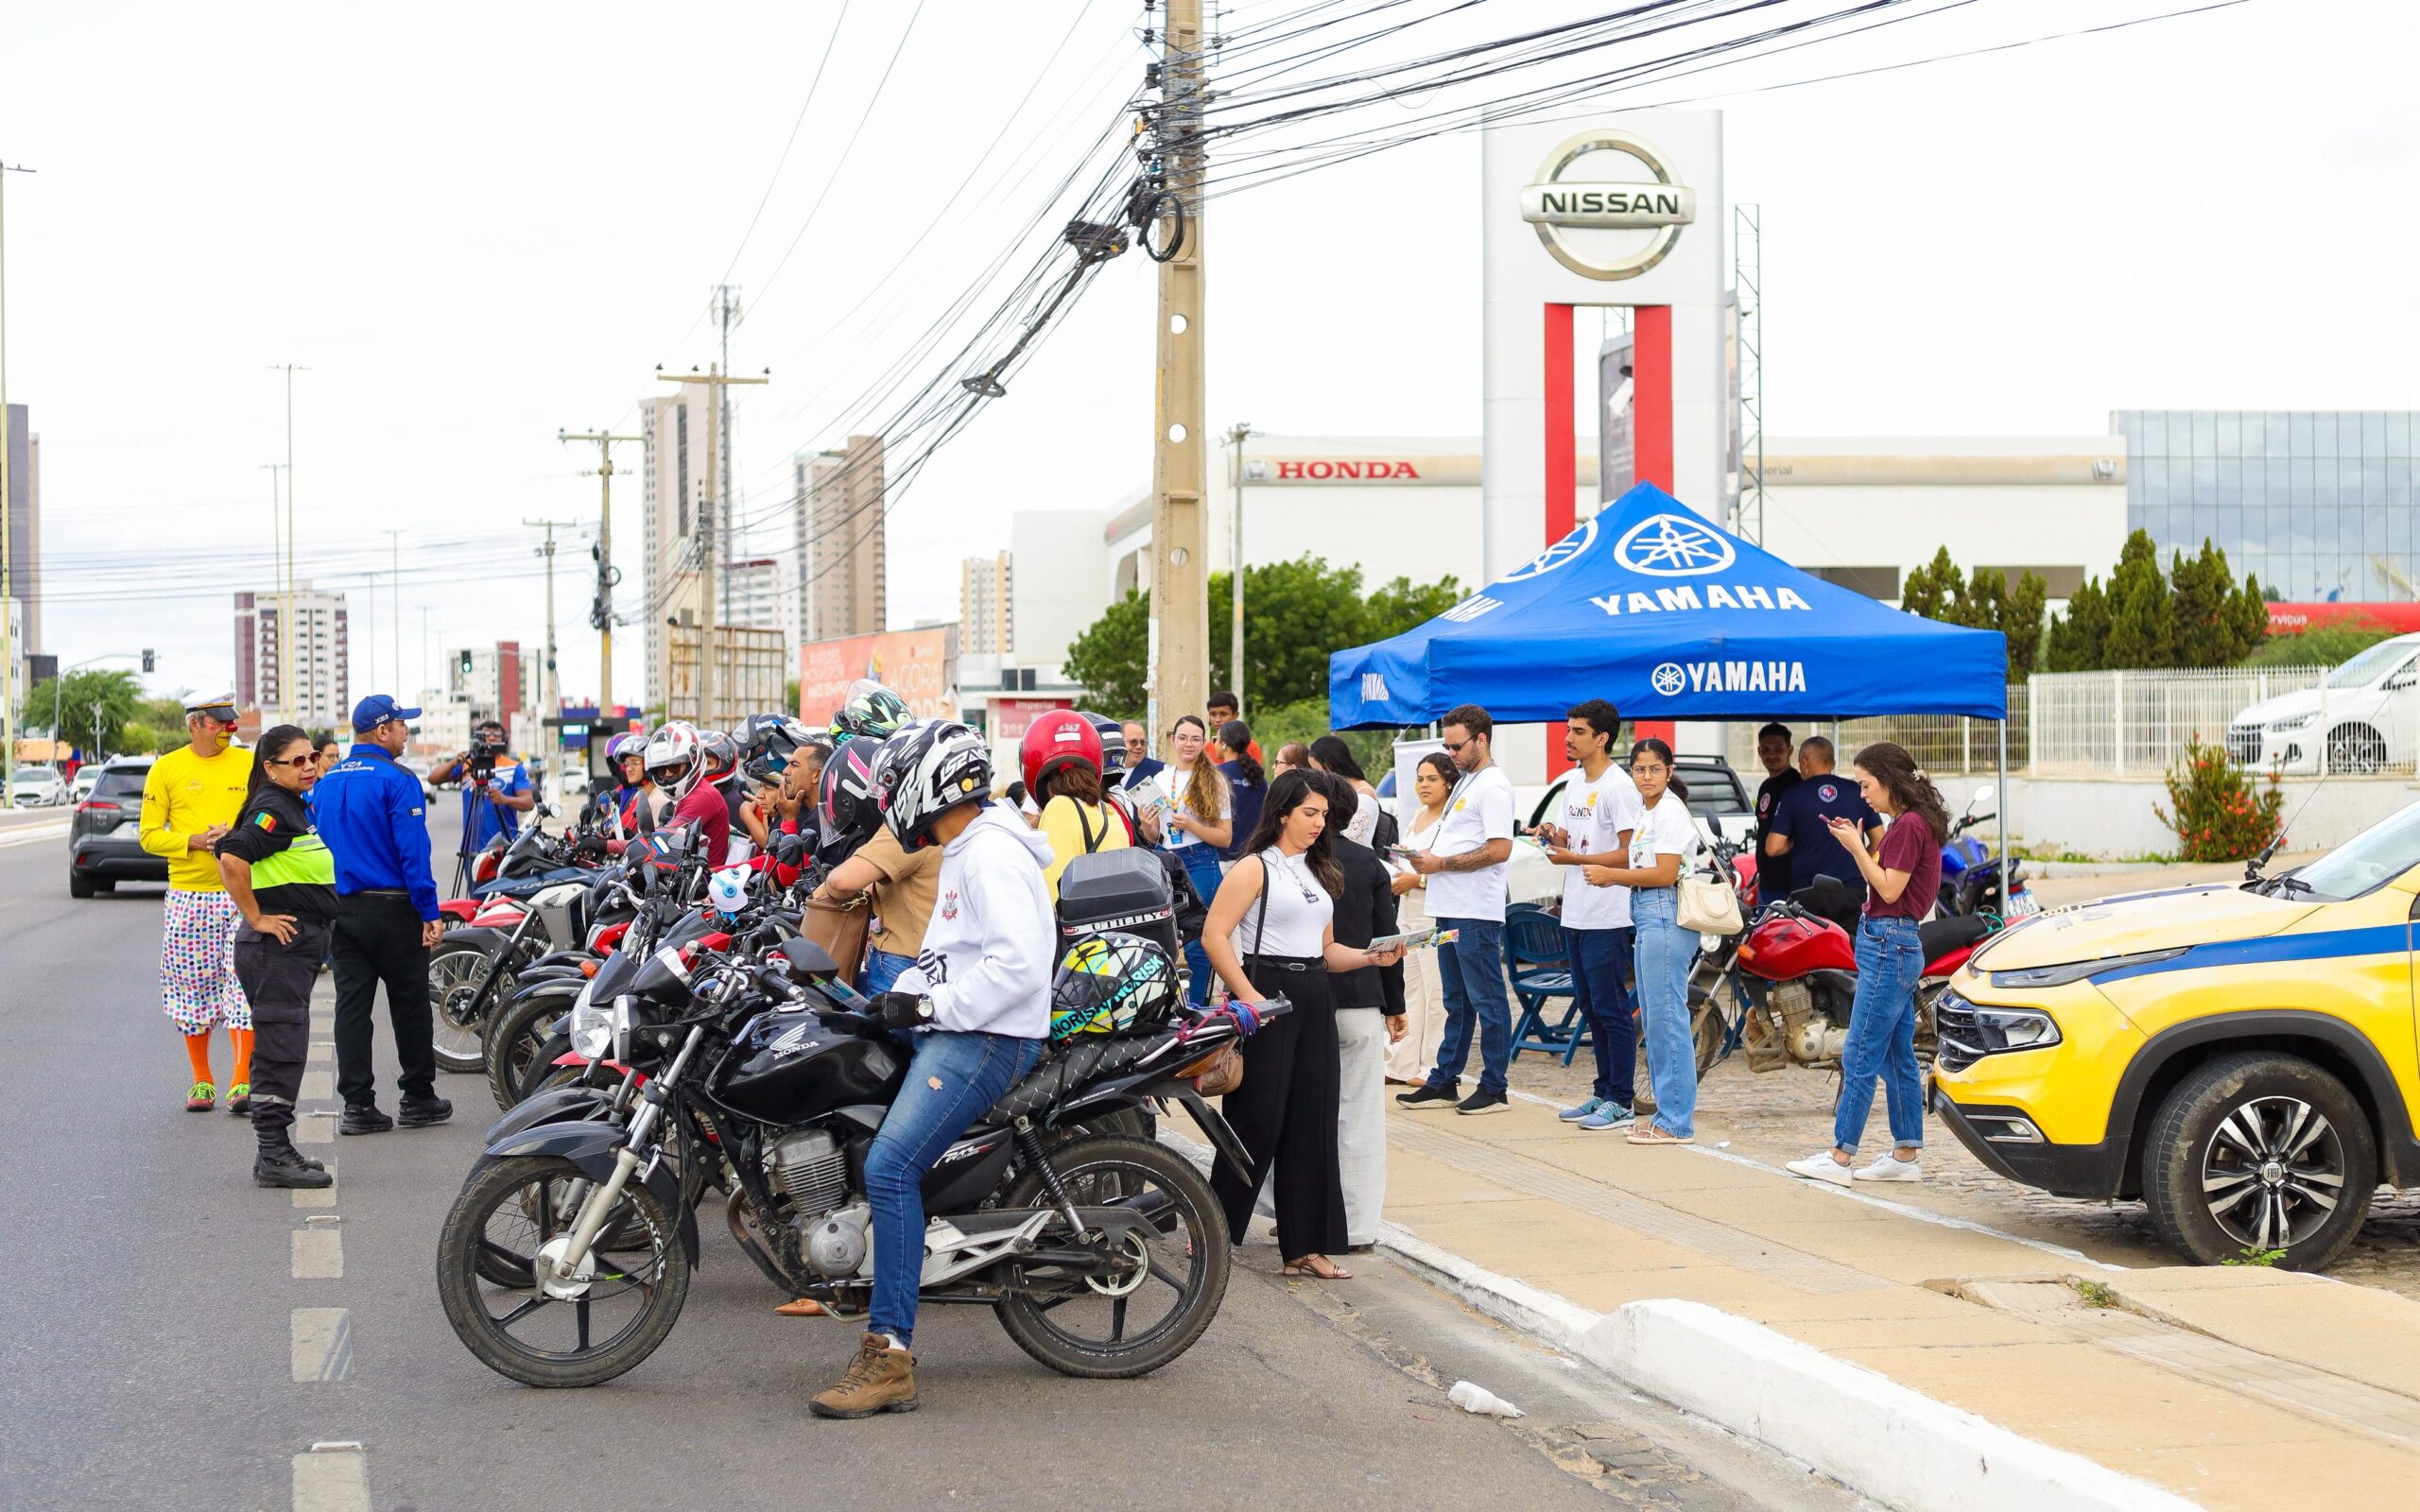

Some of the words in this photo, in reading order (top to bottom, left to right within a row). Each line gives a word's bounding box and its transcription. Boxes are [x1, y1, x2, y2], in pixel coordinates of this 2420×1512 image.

[1542, 193, 1679, 215] NISSAN
[1276, 461, 1421, 479] HONDA
[1589, 584, 1812, 615] YAMAHA
[890, 663, 939, 693] AGORA
[1686, 662, 1806, 692] YAMAHA
[1092, 912, 1158, 931] UTILITY
[1114, 954, 1165, 1002] NORISK
[773, 1041, 820, 1059] HONDA
[2268, 1168, 2279, 1178] FIAT
